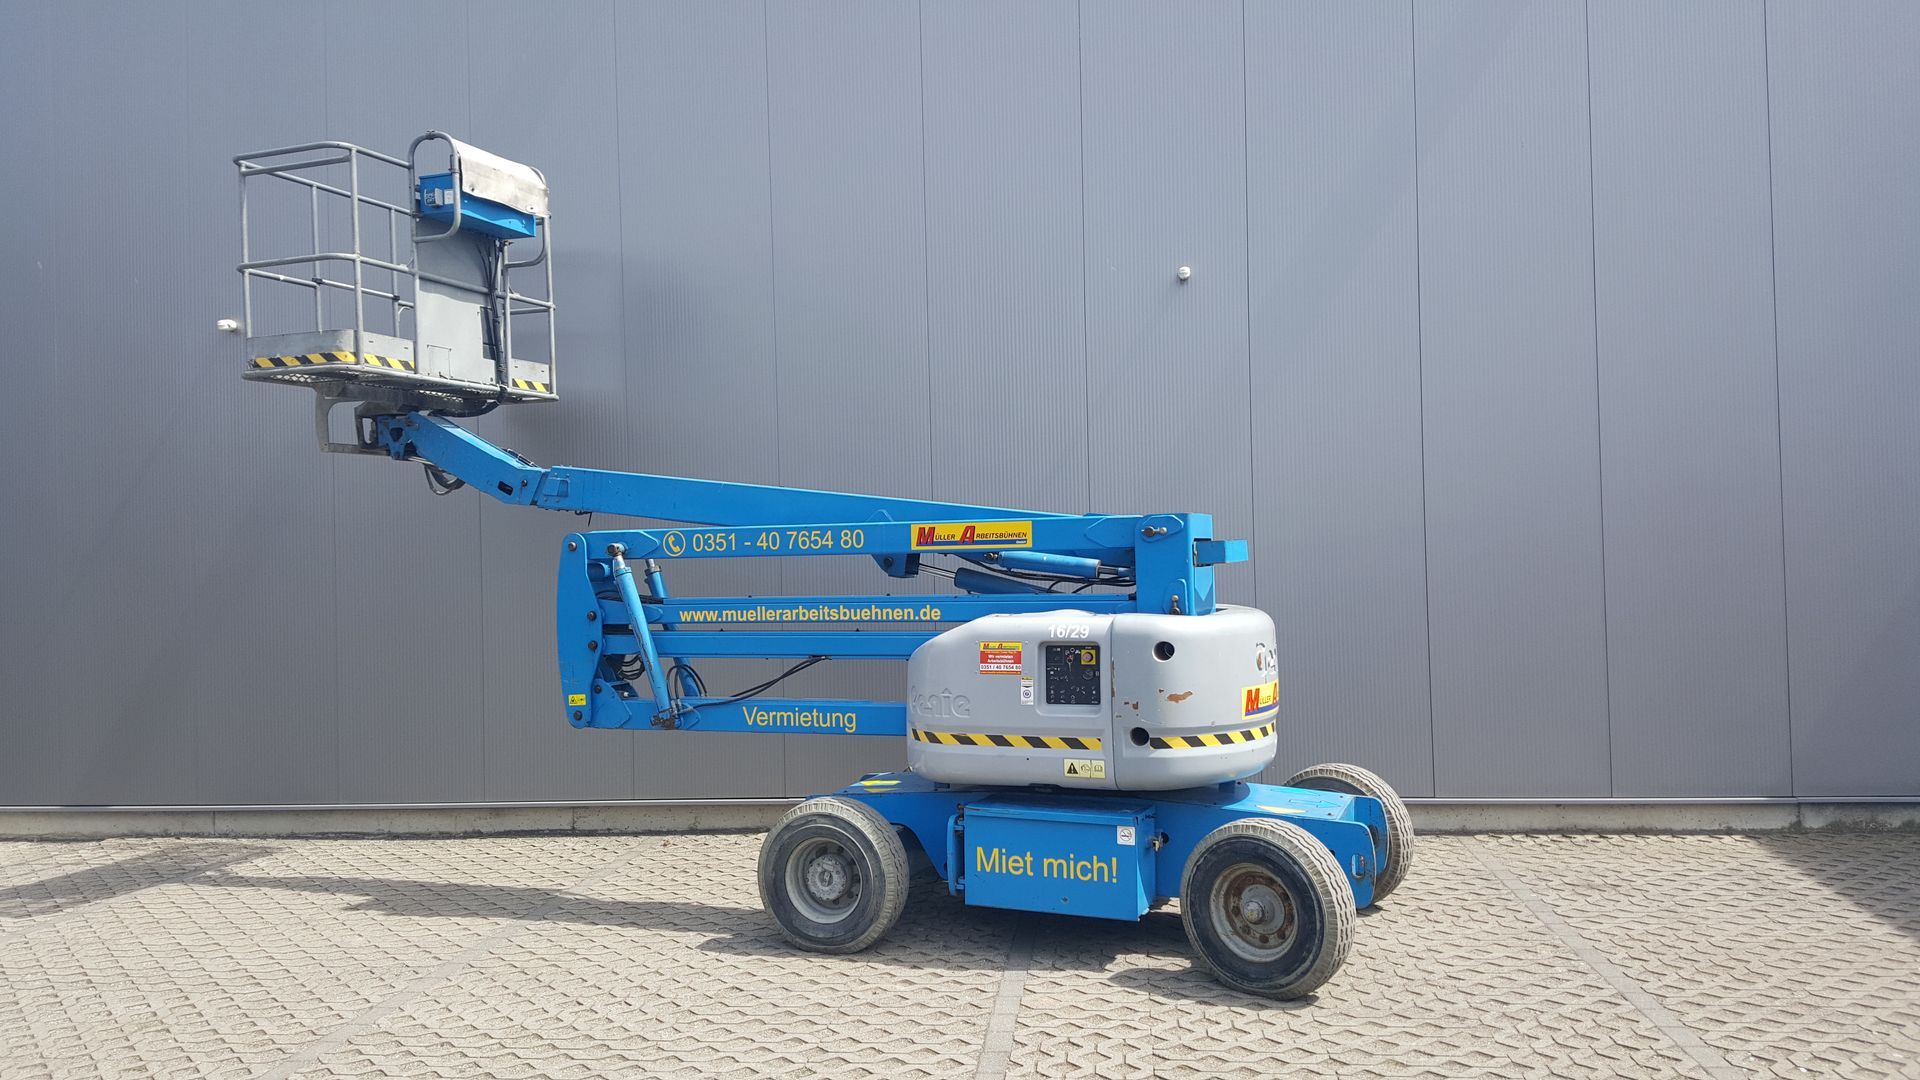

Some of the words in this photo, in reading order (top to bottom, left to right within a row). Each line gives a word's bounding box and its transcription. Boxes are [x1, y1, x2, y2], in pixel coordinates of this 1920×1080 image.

[693, 533, 735, 552] 0351
[757, 531, 780, 550] 40
[786, 529, 834, 550] 7654
[840, 529, 864, 549] 80
[680, 604, 941, 622] www.muellerarbeitsbuehnen.de
[1048, 624, 1090, 639] 16/29
[743, 706, 857, 733] Vermietung
[976, 846, 1034, 877] Miet
[1043, 853, 1118, 883] mich!
